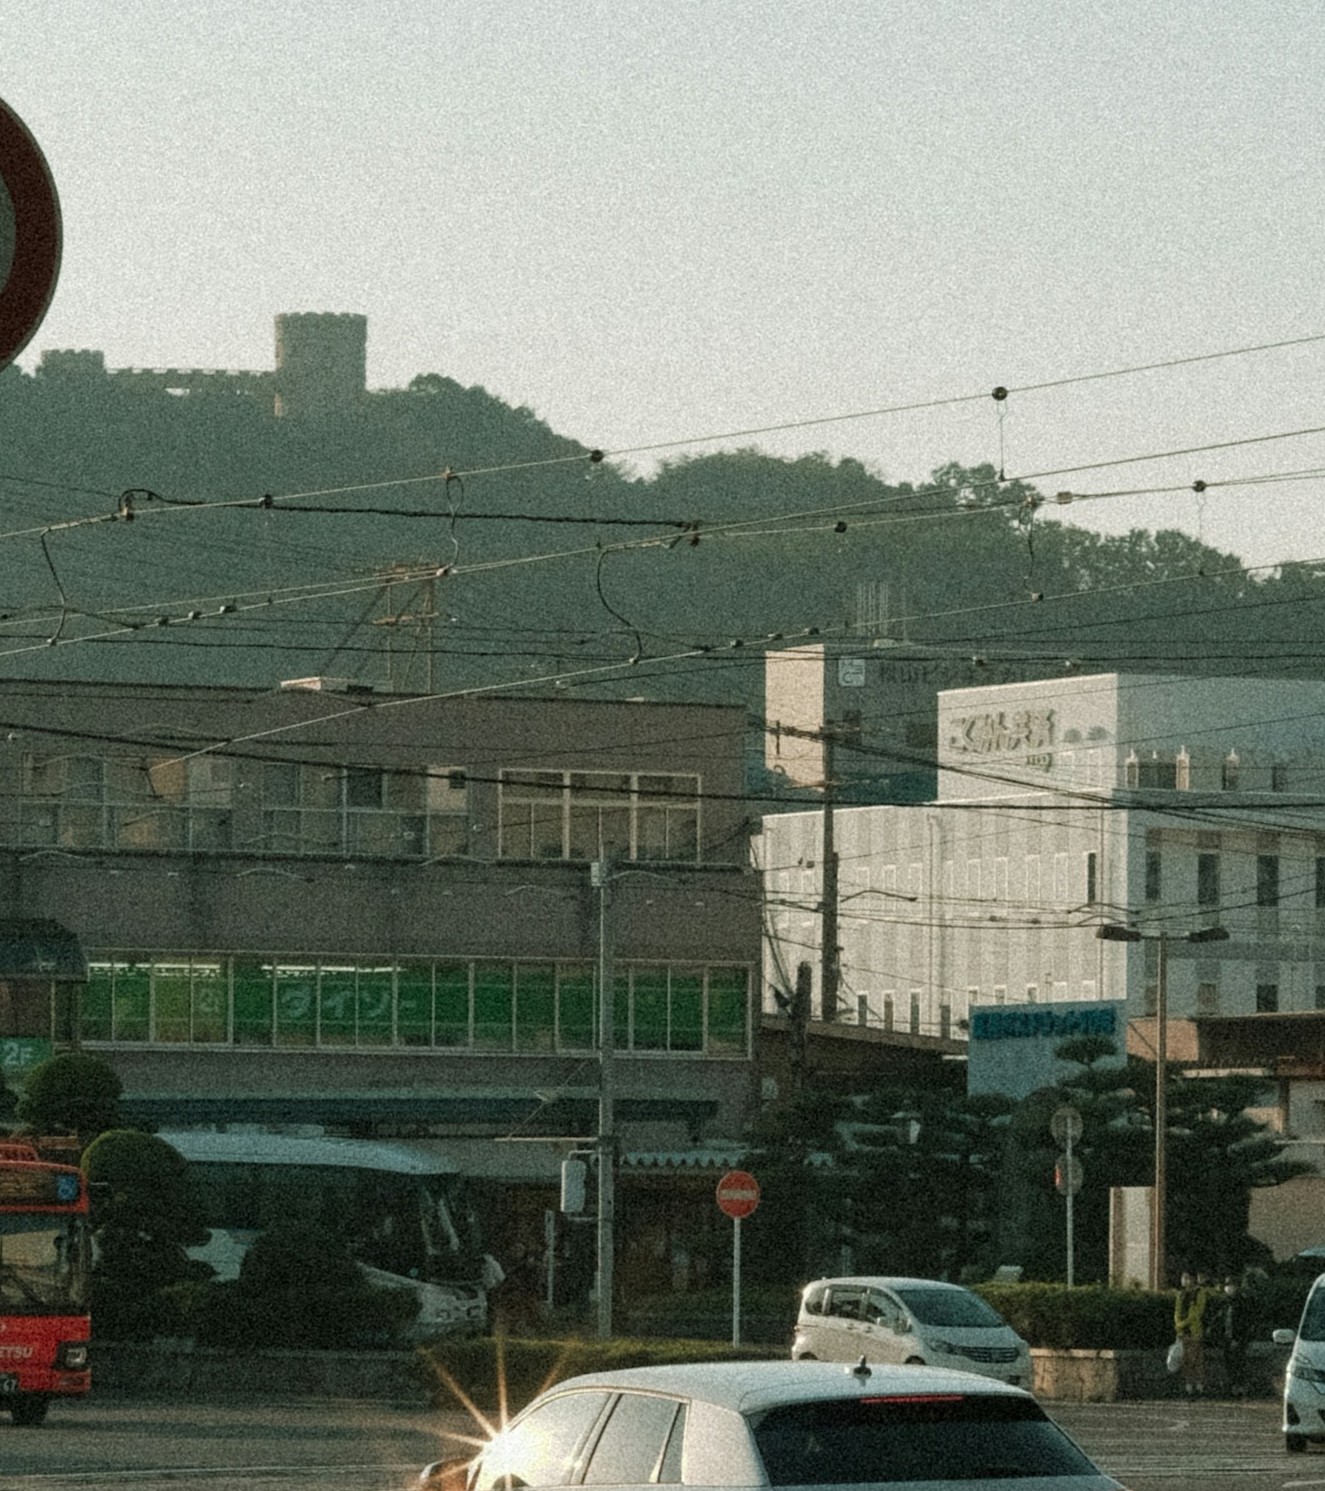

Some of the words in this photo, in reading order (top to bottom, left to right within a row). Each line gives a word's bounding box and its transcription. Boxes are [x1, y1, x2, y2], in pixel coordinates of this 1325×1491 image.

[279, 985, 418, 1019] ダイソー
[2, 1039, 34, 1066] 2F
